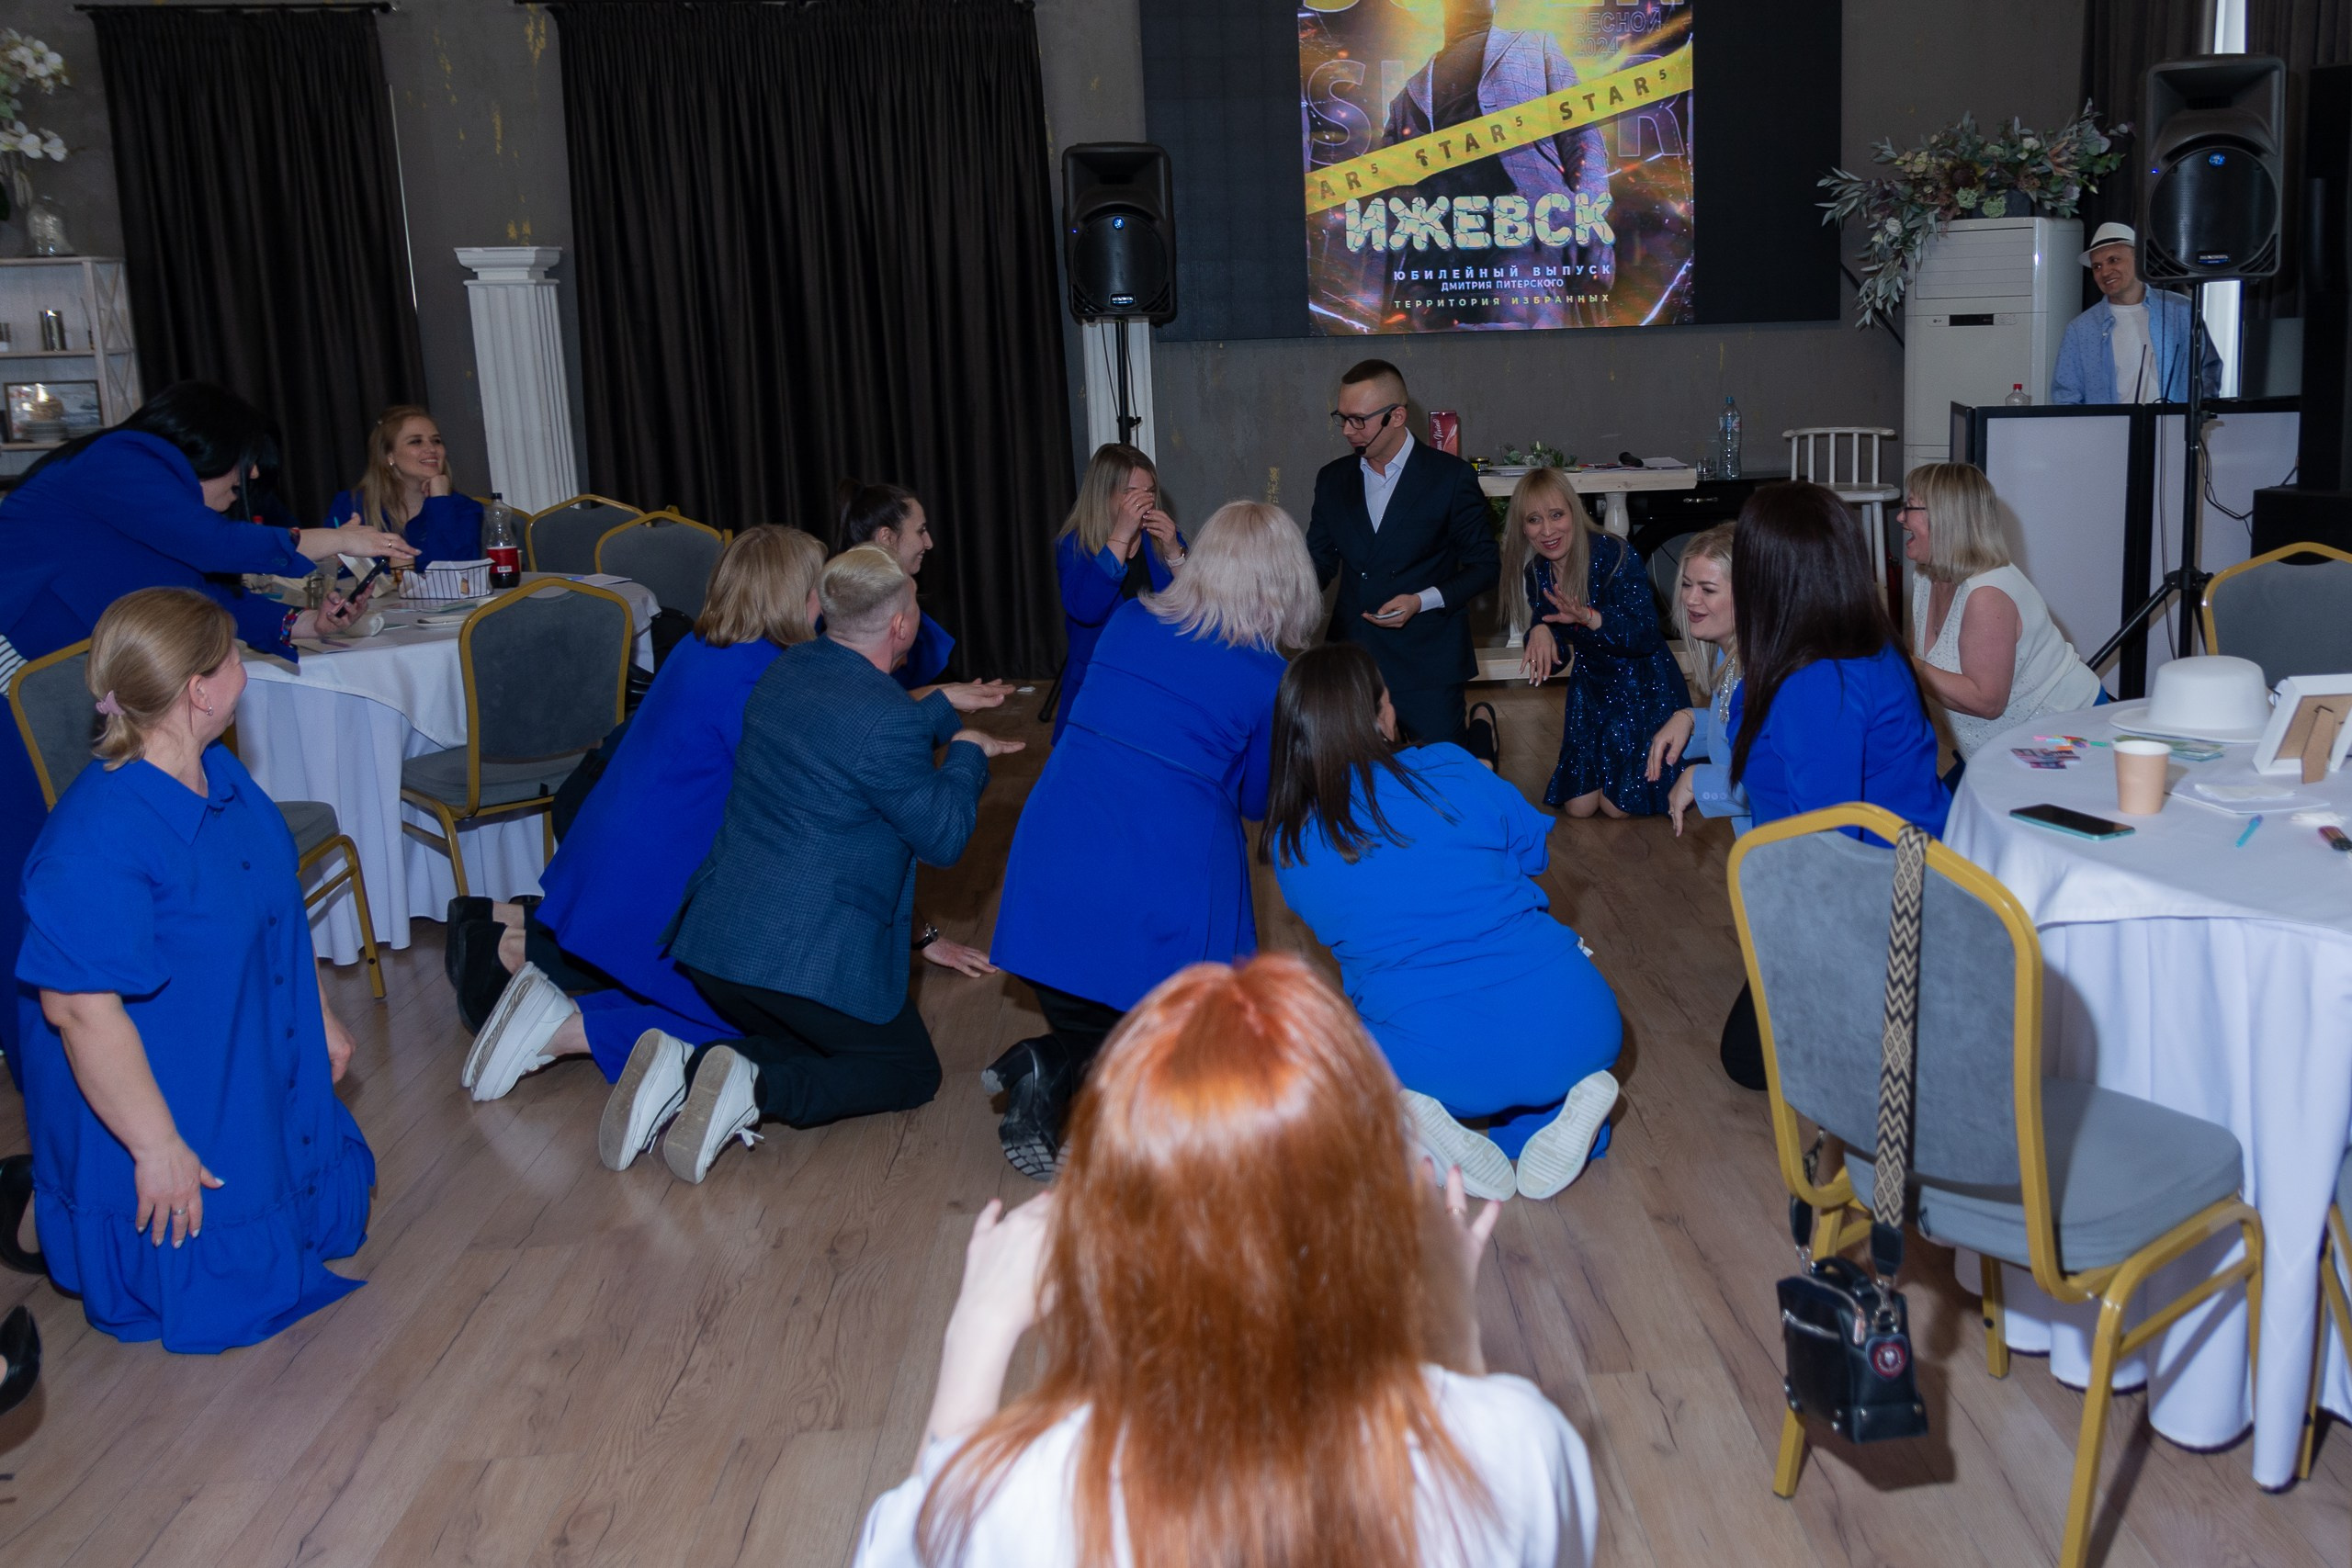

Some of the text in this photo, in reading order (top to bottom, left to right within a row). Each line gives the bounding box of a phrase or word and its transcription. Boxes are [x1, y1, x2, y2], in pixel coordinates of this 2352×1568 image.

[1573, 7, 1661, 33] ВЕСНОЙ
[1576, 37, 1620, 58] 2024
[1345, 192, 1616, 252] ИЖЕВСК
[1394, 265, 1611, 280] ЮБИЛЕЙНЫЙ ВЫПУСК
[1441, 278, 1564, 292] ДМИТРИЯ ПИТЕРСКОГО
[1394, 294, 1609, 309] ТЕРРИТОРИЯ ИЗБРАННЫХ
